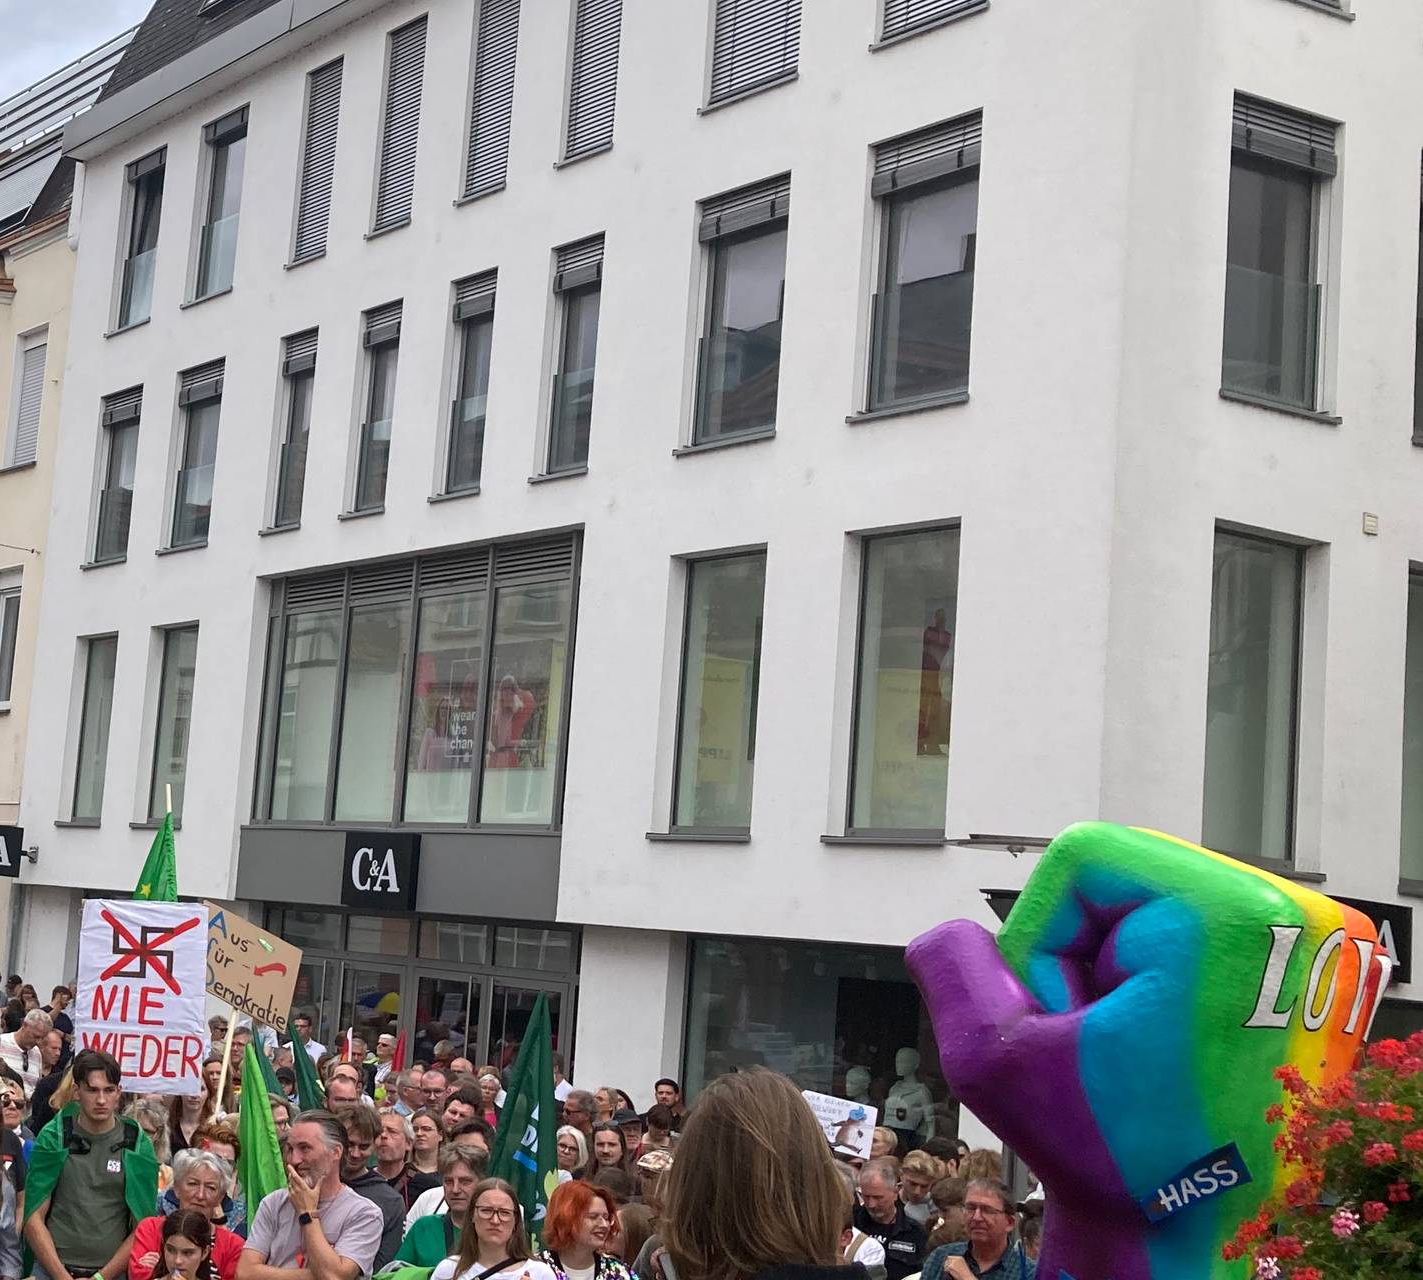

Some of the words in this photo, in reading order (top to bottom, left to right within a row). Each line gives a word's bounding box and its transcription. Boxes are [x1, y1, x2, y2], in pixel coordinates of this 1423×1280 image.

[451, 722, 467, 736] the
[453, 711, 477, 721] wear
[352, 847, 400, 893] C&A
[208, 911, 249, 953] Aus
[92, 985, 165, 1026] NIE
[1157, 1160, 1239, 1212] HASS
